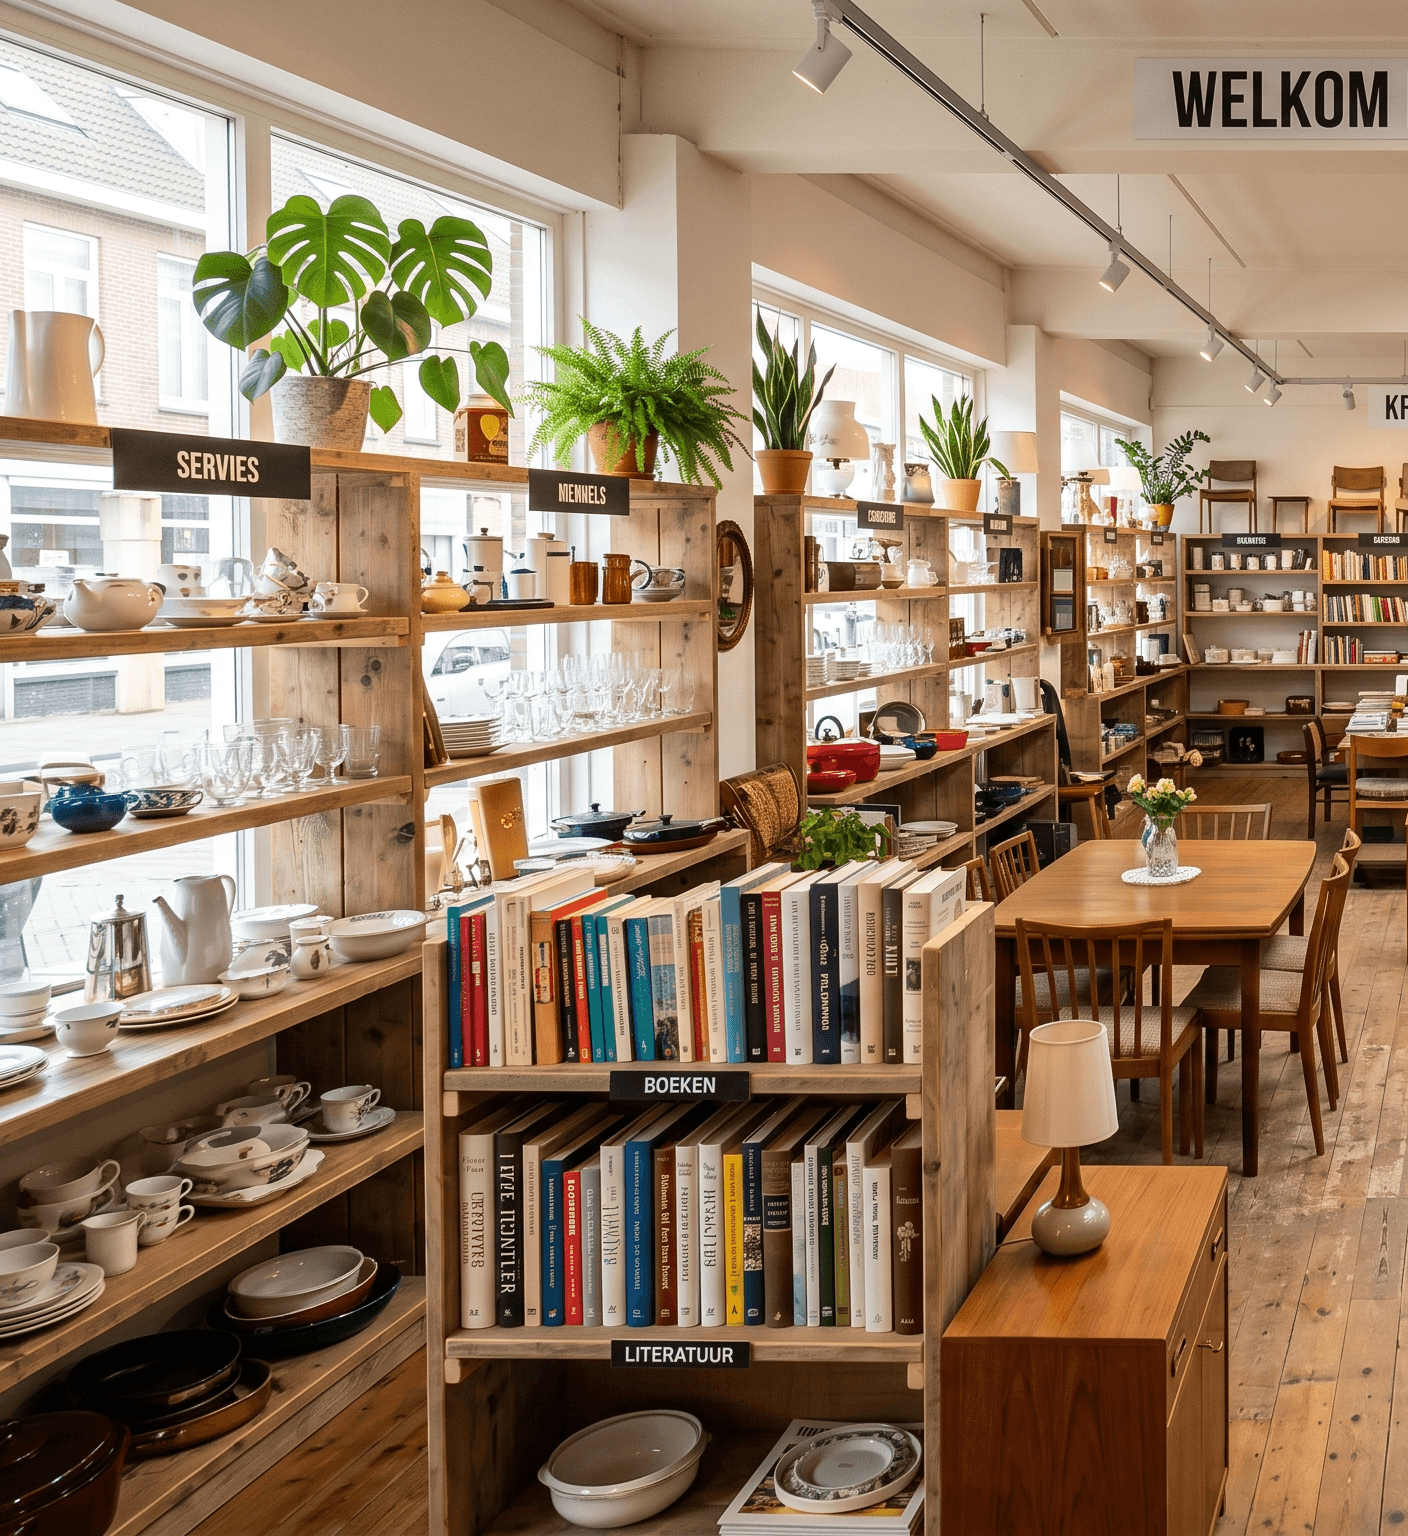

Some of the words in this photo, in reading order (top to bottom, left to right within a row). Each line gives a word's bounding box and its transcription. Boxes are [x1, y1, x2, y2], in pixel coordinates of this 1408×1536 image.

[1172, 69, 1389, 129] WELKOM
[176, 450, 260, 484] SERVIES
[644, 1076, 716, 1094] BOEKEN
[625, 1346, 734, 1363] LITERATUUR
